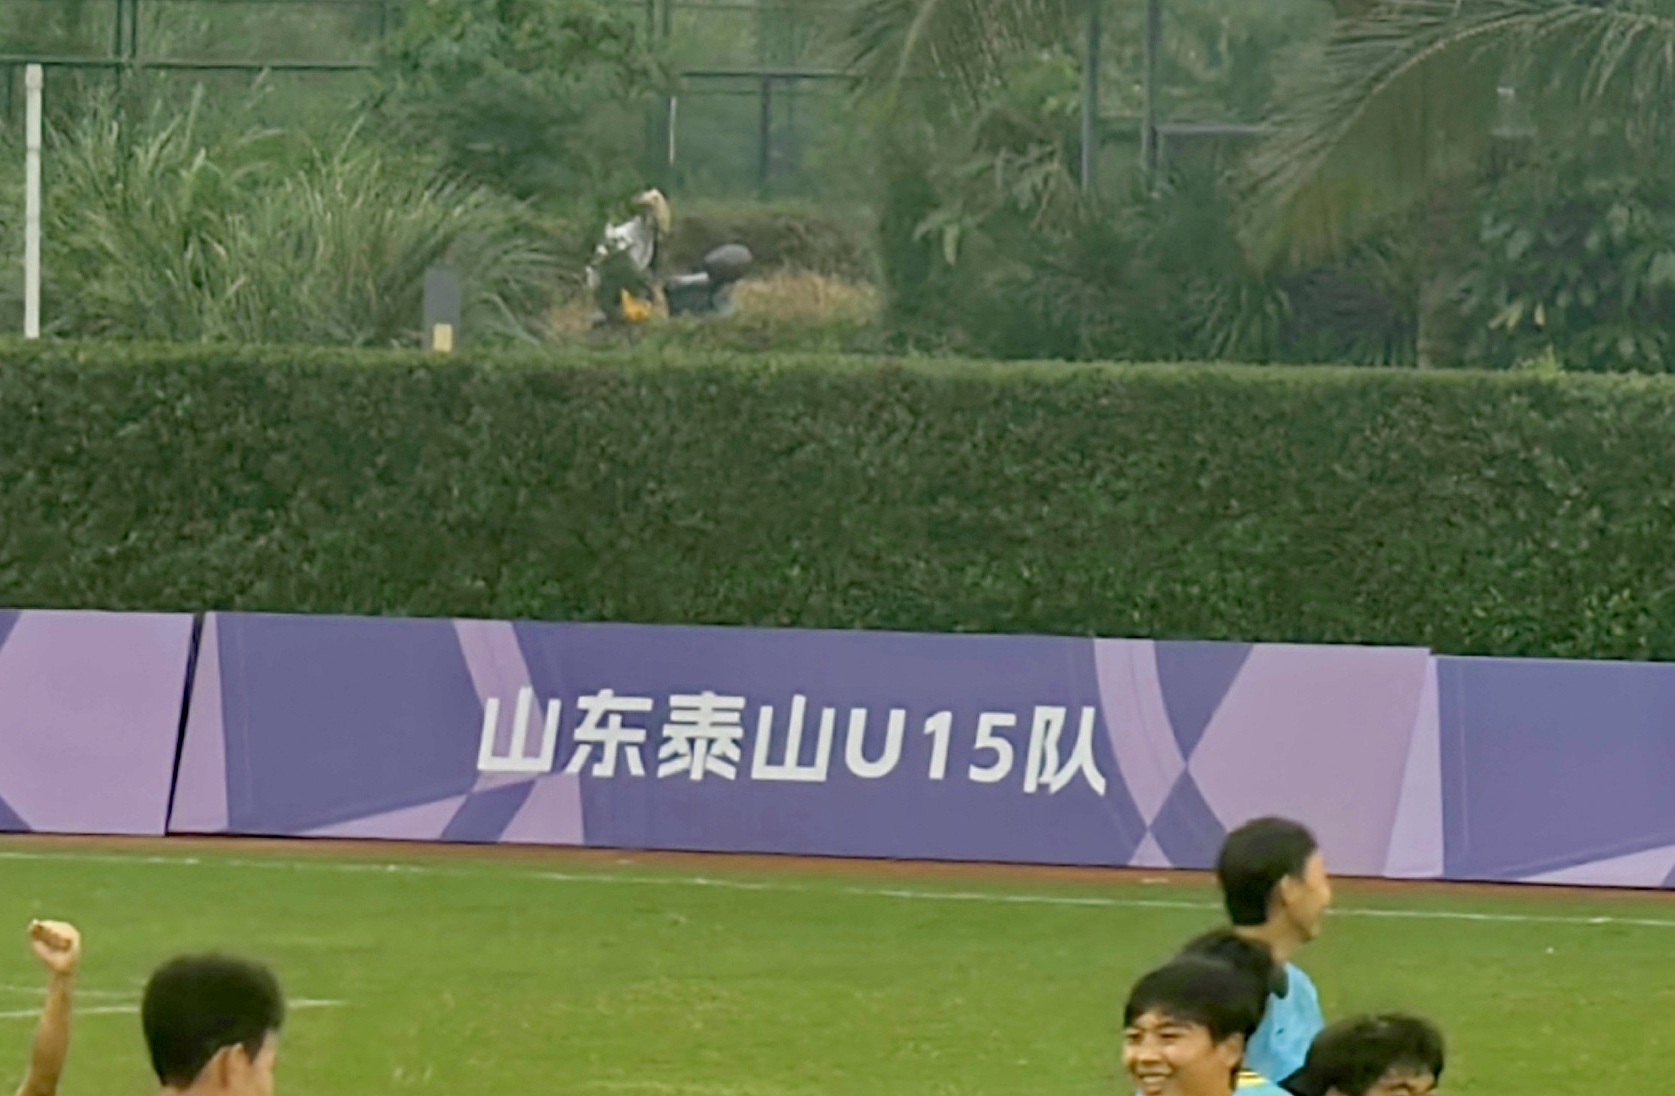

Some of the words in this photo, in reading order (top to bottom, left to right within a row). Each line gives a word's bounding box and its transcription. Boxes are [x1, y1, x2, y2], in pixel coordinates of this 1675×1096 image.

[476, 686, 1107, 797] 山东泰山U15队
